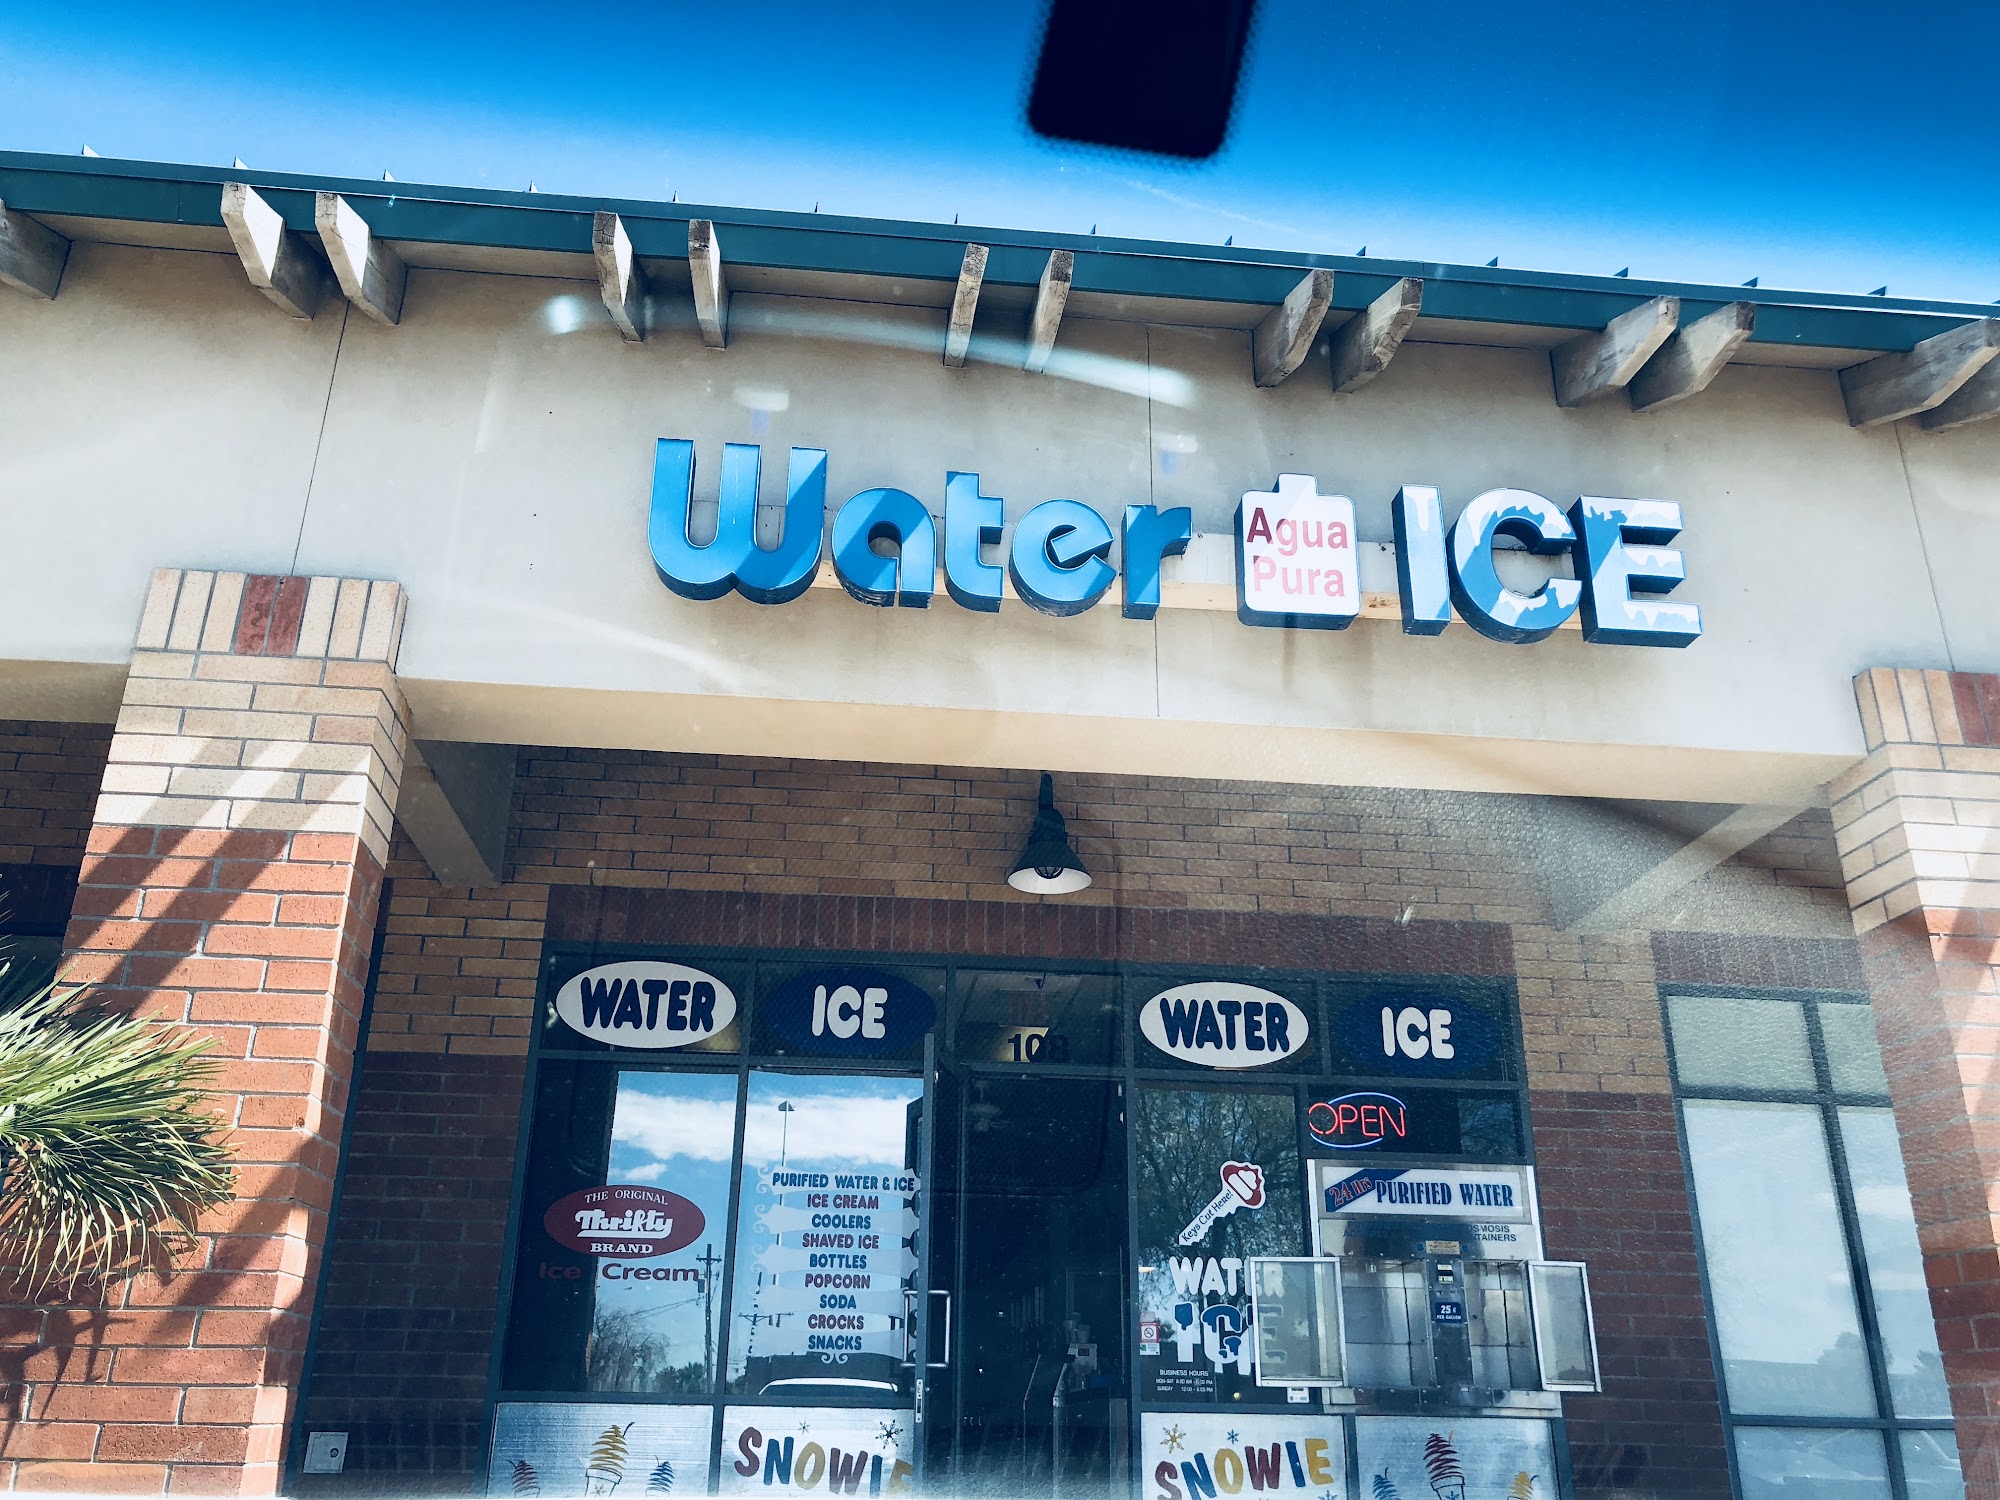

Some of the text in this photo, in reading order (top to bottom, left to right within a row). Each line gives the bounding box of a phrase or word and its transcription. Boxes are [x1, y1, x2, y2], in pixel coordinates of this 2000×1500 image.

[1246, 507, 1348, 556] Agua
[648, 438, 1702, 648] Water ICE
[1253, 555, 1345, 597] Pura
[580, 976, 716, 1032] WATER
[811, 984, 888, 1039] ICE
[1160, 997, 1291, 1053] WATER
[1381, 1006, 1455, 1060] ICE
[1007, 1033, 1071, 1063] 108
[1308, 1102, 1406, 1137] OPEN
[773, 1172, 915, 1191] PURIFIED WATER & ICE
[584, 1189, 669, 1205] THE ORIGINAL
[807, 1193, 879, 1209] ICE CREAM
[1329, 1181, 1353, 1206] 24
[1375, 1179, 1514, 1207] PURIFIED WATER
[574, 1209, 673, 1239] Thrifty
[811, 1213, 871, 1229] COOLERS
[1181, 1189, 1234, 1242] Keys Cut Here!
[590, 1242, 653, 1254] BRAND
[802, 1233, 879, 1249] SHAVED ICE
[1475, 1233, 1517, 1242] TAINERS
[538, 1262, 700, 1282] Ice Cream
[809, 1253, 867, 1269] BOTTLES
[805, 1273, 871, 1289] POPCORN
[819, 1294, 857, 1309] SODA
[1441, 1305, 1451, 1314] 25
[807, 1314, 864, 1330] CROCKS
[807, 1335, 862, 1350] SNACKS
[1155, 1438, 1334, 1500] SNOWIE
